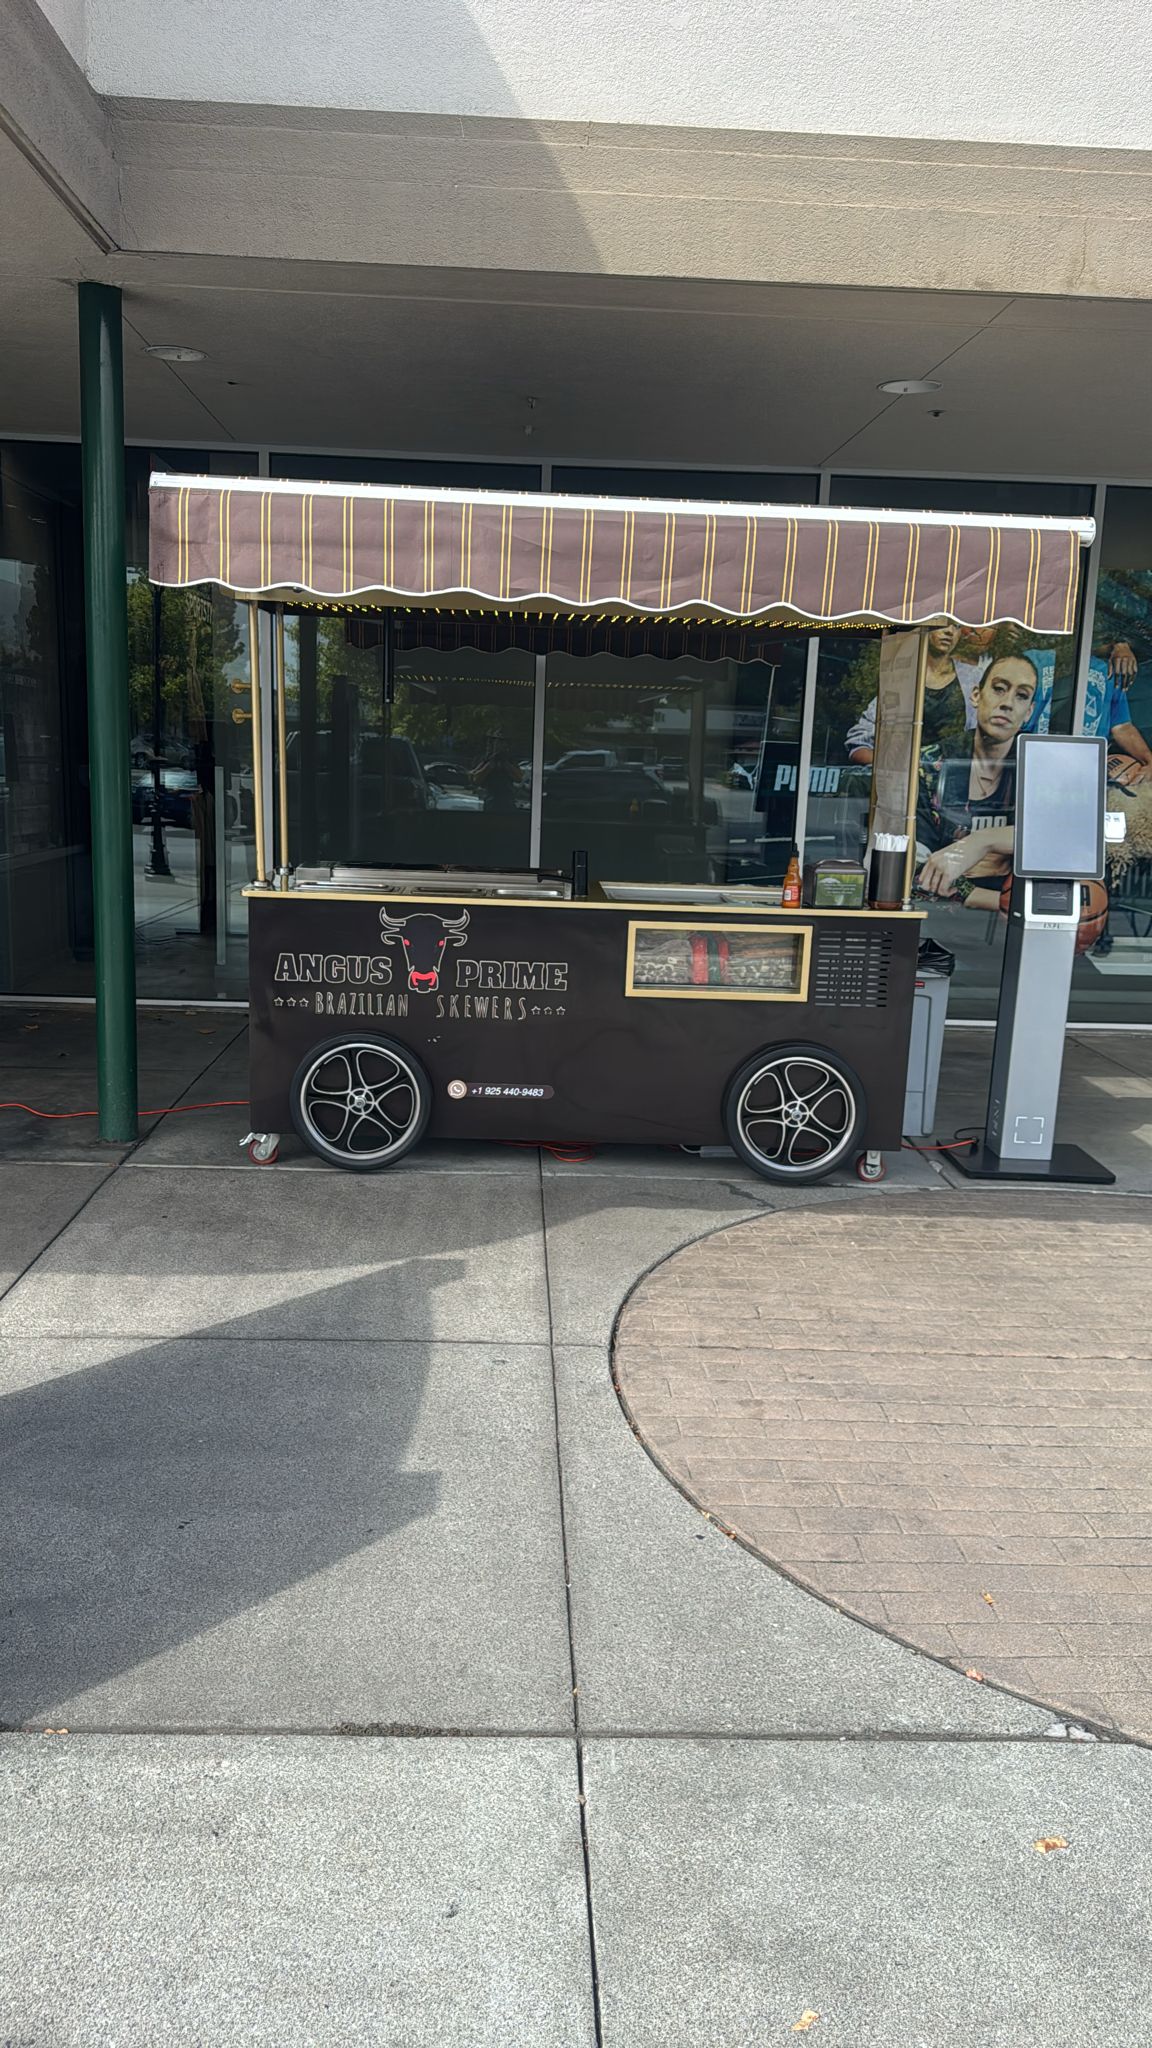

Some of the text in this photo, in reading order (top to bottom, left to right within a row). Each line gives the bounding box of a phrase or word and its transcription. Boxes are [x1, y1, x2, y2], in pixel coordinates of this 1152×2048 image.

[274, 952, 568, 992] ANGUS PRIME
[314, 991, 528, 1020] BRAZILIAN SKEWERS
[471, 1086, 544, 1097] +1 925 440-9483
